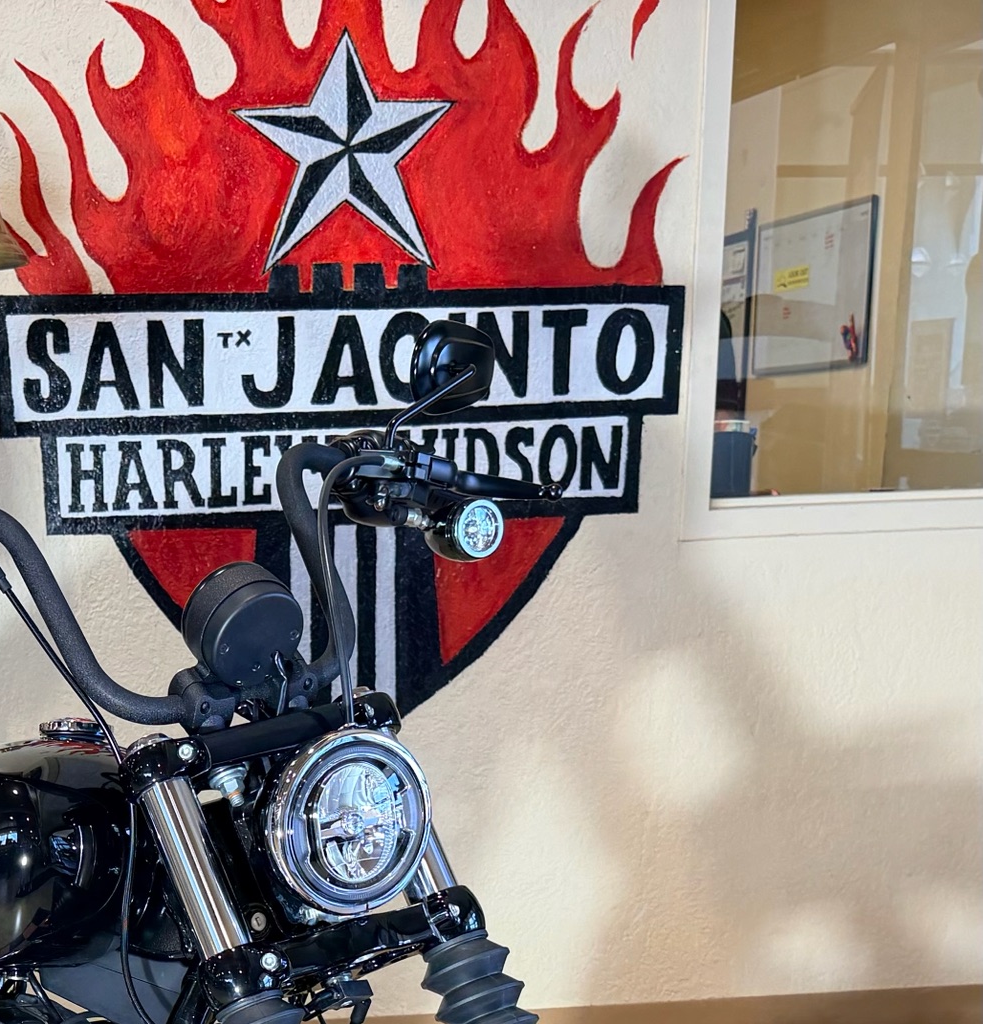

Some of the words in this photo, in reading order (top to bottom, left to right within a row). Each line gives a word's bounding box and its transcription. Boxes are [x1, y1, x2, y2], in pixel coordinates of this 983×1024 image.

[23, 318, 205, 414] SAN
[216, 329, 253, 349] TX
[241, 308, 656, 409] JACNTO
